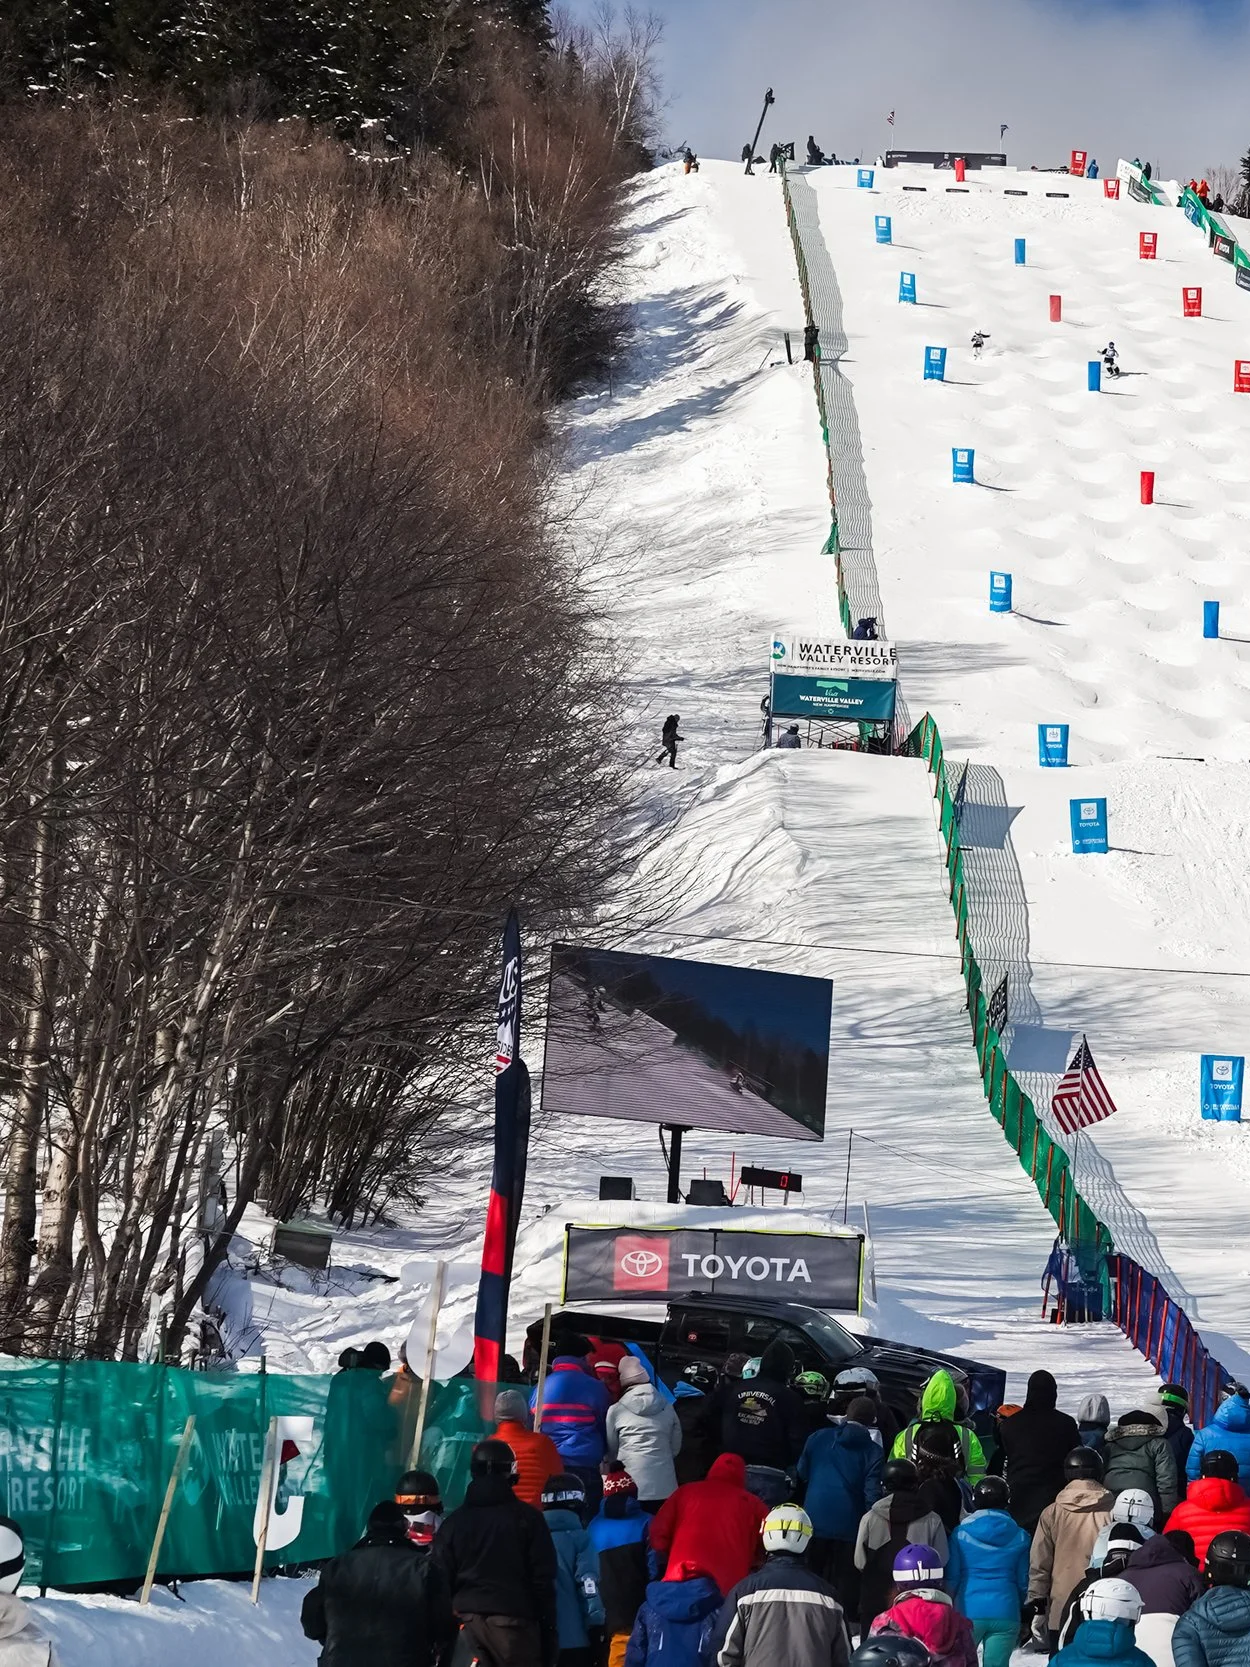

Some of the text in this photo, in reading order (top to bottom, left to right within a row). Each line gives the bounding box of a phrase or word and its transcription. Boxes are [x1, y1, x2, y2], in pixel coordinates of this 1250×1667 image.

[799, 643, 897, 658] WATERVILLE
[799, 653, 897, 666] VALLEY RESORT
[799, 695, 839, 704] WATERVILLE
[681, 1253, 812, 1283] TOYOTA
[738, 1391, 776, 1406] UNIVERSAL
[11, 1476, 86, 1511] RESORT
